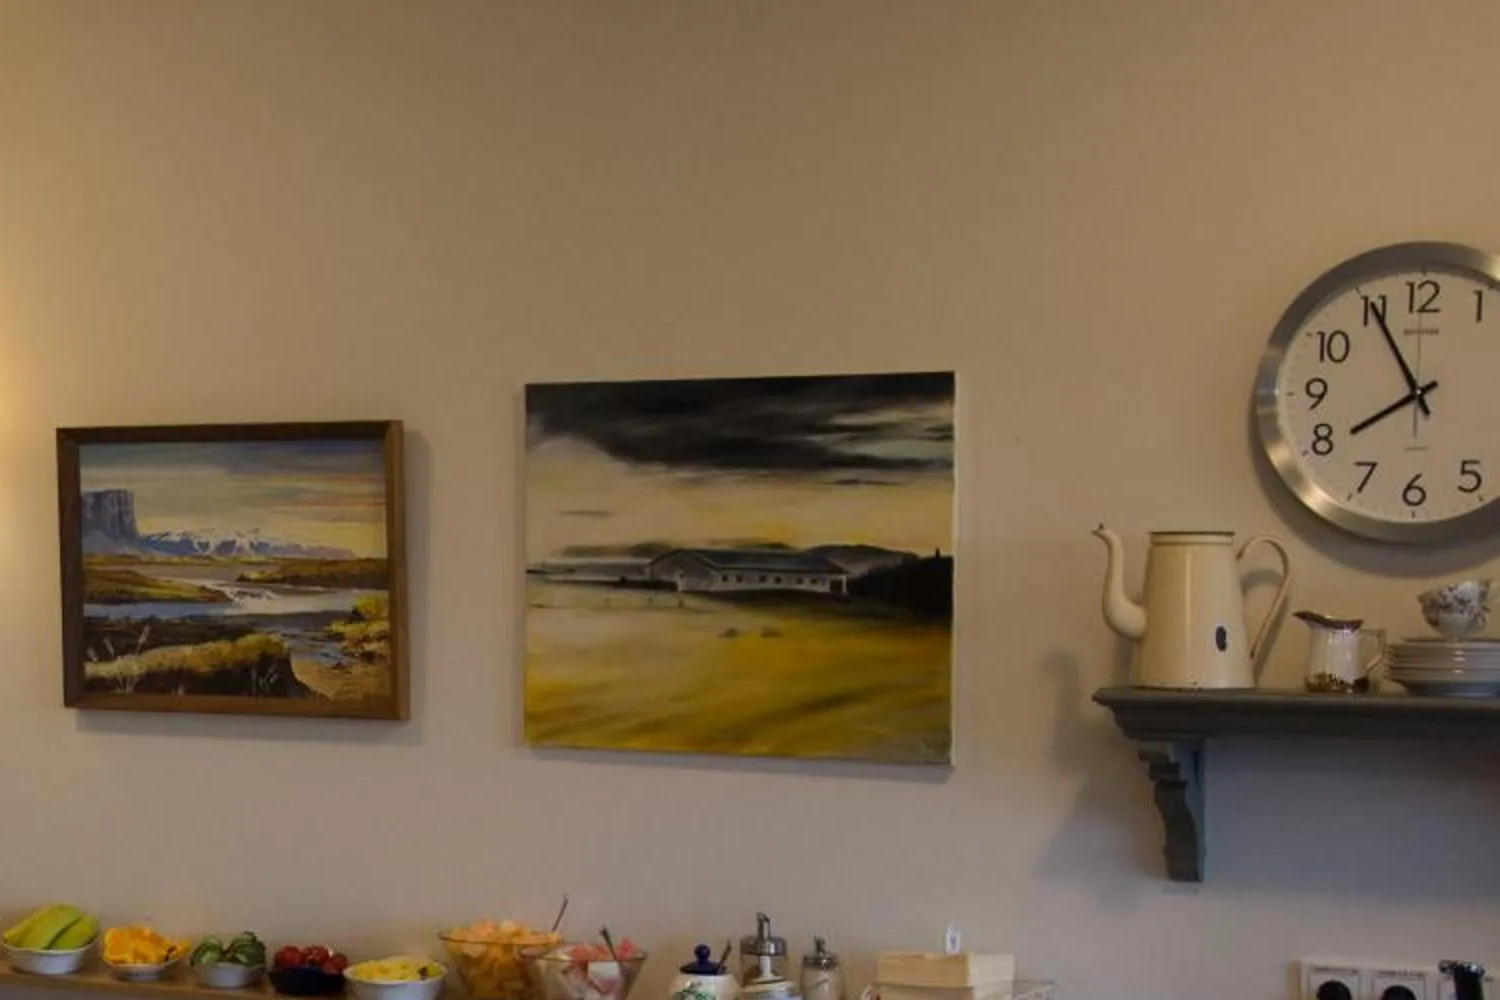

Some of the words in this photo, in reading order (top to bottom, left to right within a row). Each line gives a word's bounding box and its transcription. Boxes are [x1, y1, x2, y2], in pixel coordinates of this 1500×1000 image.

[1360, 294, 1388, 329] 11
[1405, 279, 1442, 315] 12
[1473, 288, 1485, 324] 1
[1315, 329, 1352, 365] 10
[1304, 376, 1329, 411] 9
[1310, 422, 1335, 457] 8
[1353, 460, 1379, 494] 7
[1401, 473, 1428, 508] 6
[1456, 458, 1484, 494] 5
